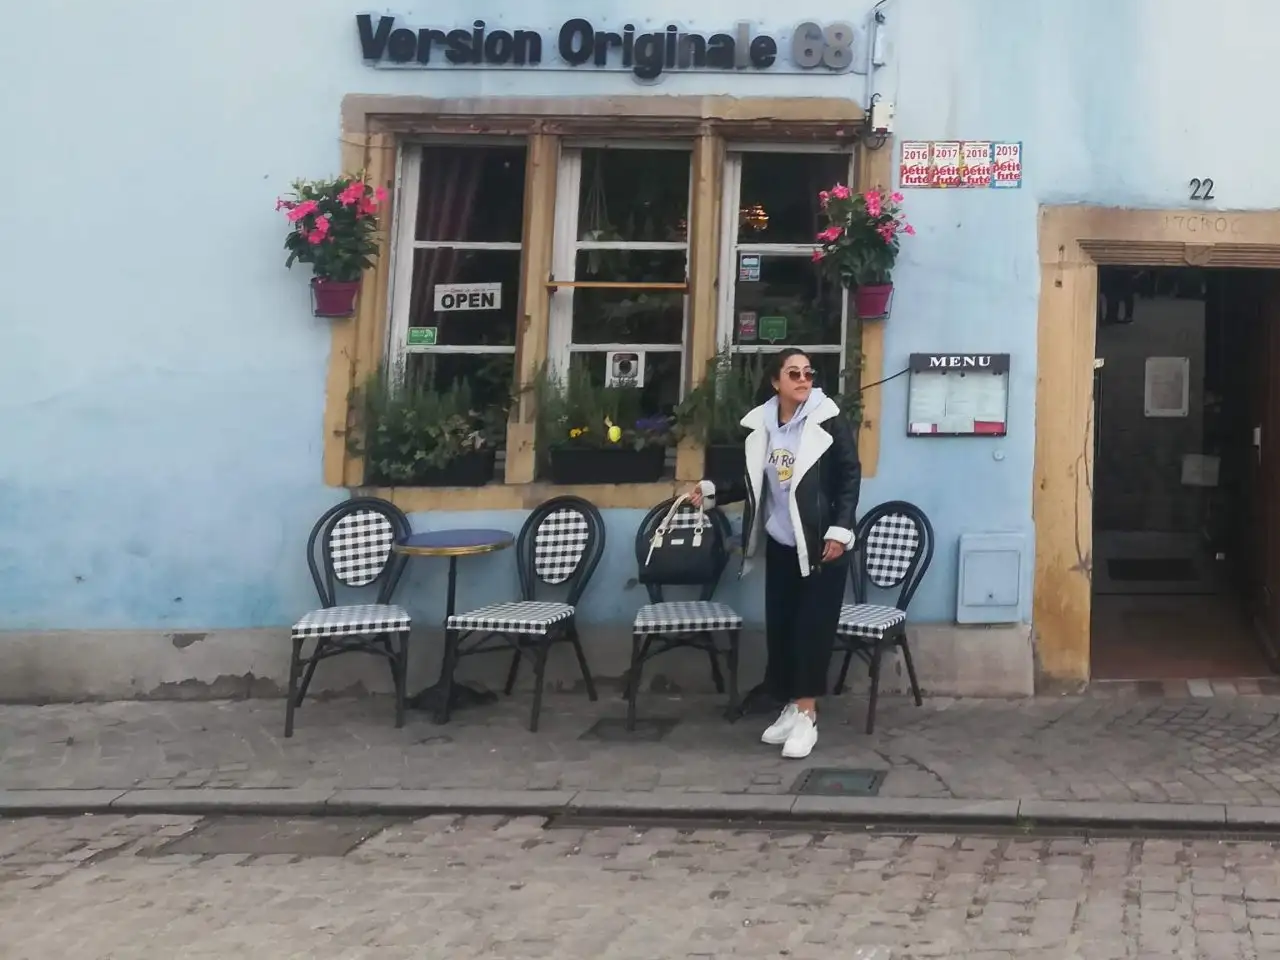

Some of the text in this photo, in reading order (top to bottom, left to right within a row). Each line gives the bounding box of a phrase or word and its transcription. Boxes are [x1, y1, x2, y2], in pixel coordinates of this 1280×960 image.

[355, 13, 856, 80] Version Originale 68
[904, 150, 928, 160] 2016
[935, 149, 958, 158] 2017
[966, 149, 988, 158] 2018
[995, 145, 1019, 156] 2019
[1188, 177, 1215, 201] 22
[441, 292, 495, 309] OPEN
[929, 356, 992, 368] MENU
